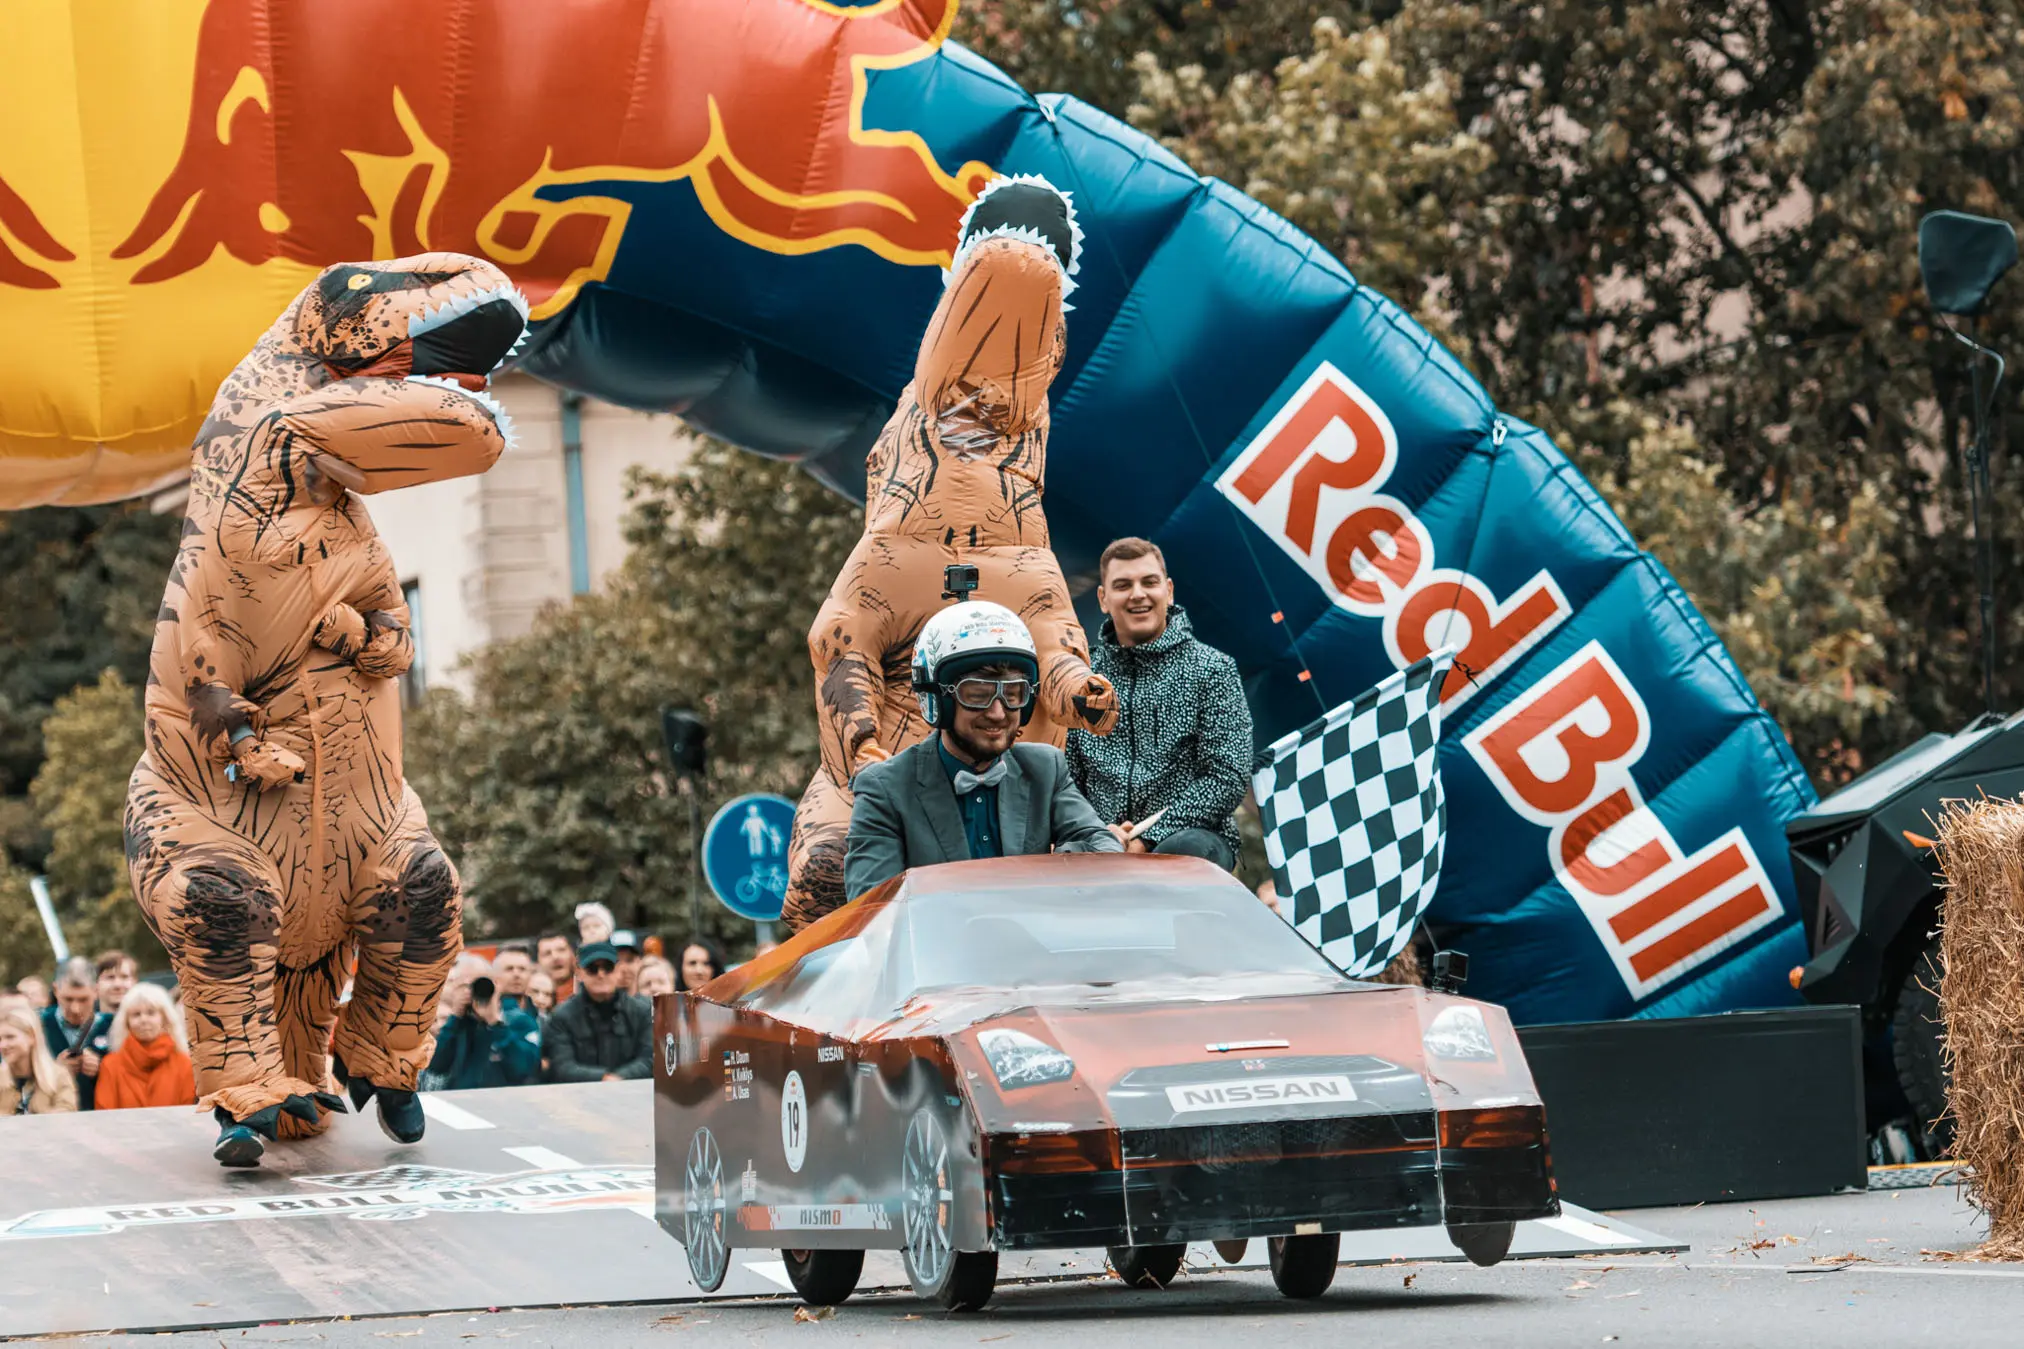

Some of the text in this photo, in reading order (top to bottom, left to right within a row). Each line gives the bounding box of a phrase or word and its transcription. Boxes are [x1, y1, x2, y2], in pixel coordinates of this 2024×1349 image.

[1215, 360, 1785, 1001] Red Bull
[817, 1046, 844, 1063] NISSAN
[1183, 1081, 1341, 1106] NISSAN
[788, 1101, 800, 1148] 19
[106, 1205, 236, 1221] RED
[258, 1194, 418, 1212] BULL
